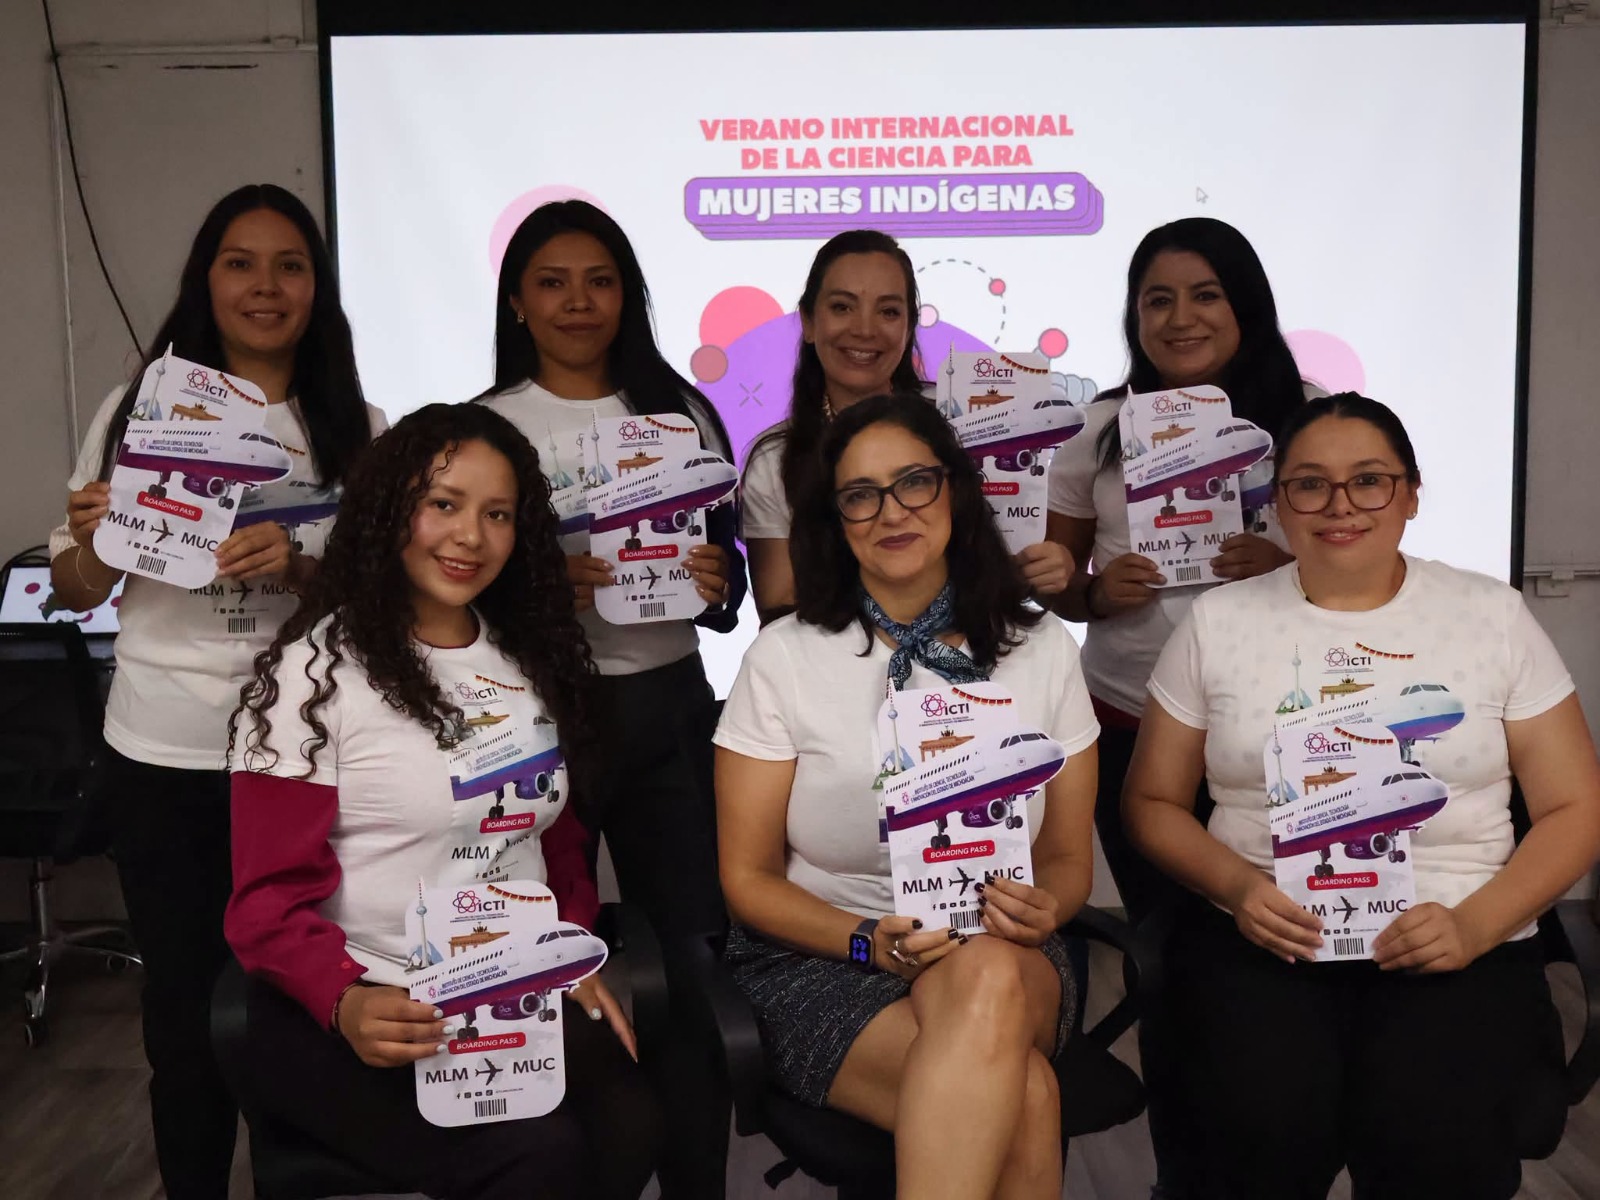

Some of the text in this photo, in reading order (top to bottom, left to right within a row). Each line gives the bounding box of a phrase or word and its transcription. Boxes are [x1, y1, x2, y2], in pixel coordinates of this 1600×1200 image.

[699, 115, 1074, 141] VERANO INTERNACIONAL
[740, 144, 1033, 170] DE LA CIENCIA PARA
[698, 180, 1076, 221] MUJERES INDÍGENAS
[143, 496, 196, 517] BOARDING PASS
[1007, 506, 1040, 518] MUC
[1160, 515, 1192, 525] BOARDING
[107, 510, 219, 552] MLM MUC
[624, 548, 673, 558] BOARDING PASS
[1138, 539, 1171, 553] MLM
[613, 569, 692, 586] LM MU
[486, 817, 531, 829] BOARDING PASS
[451, 846, 490, 859] MLM
[929, 845, 988, 859] BOARDING PASS
[902, 877, 943, 895] MLM
[1314, 876, 1371, 887] BOARDING PASS
[1367, 899, 1408, 915] MUC
[456, 1037, 518, 1050] BOARDING PASS
[425, 1057, 556, 1084] MLM MUC
